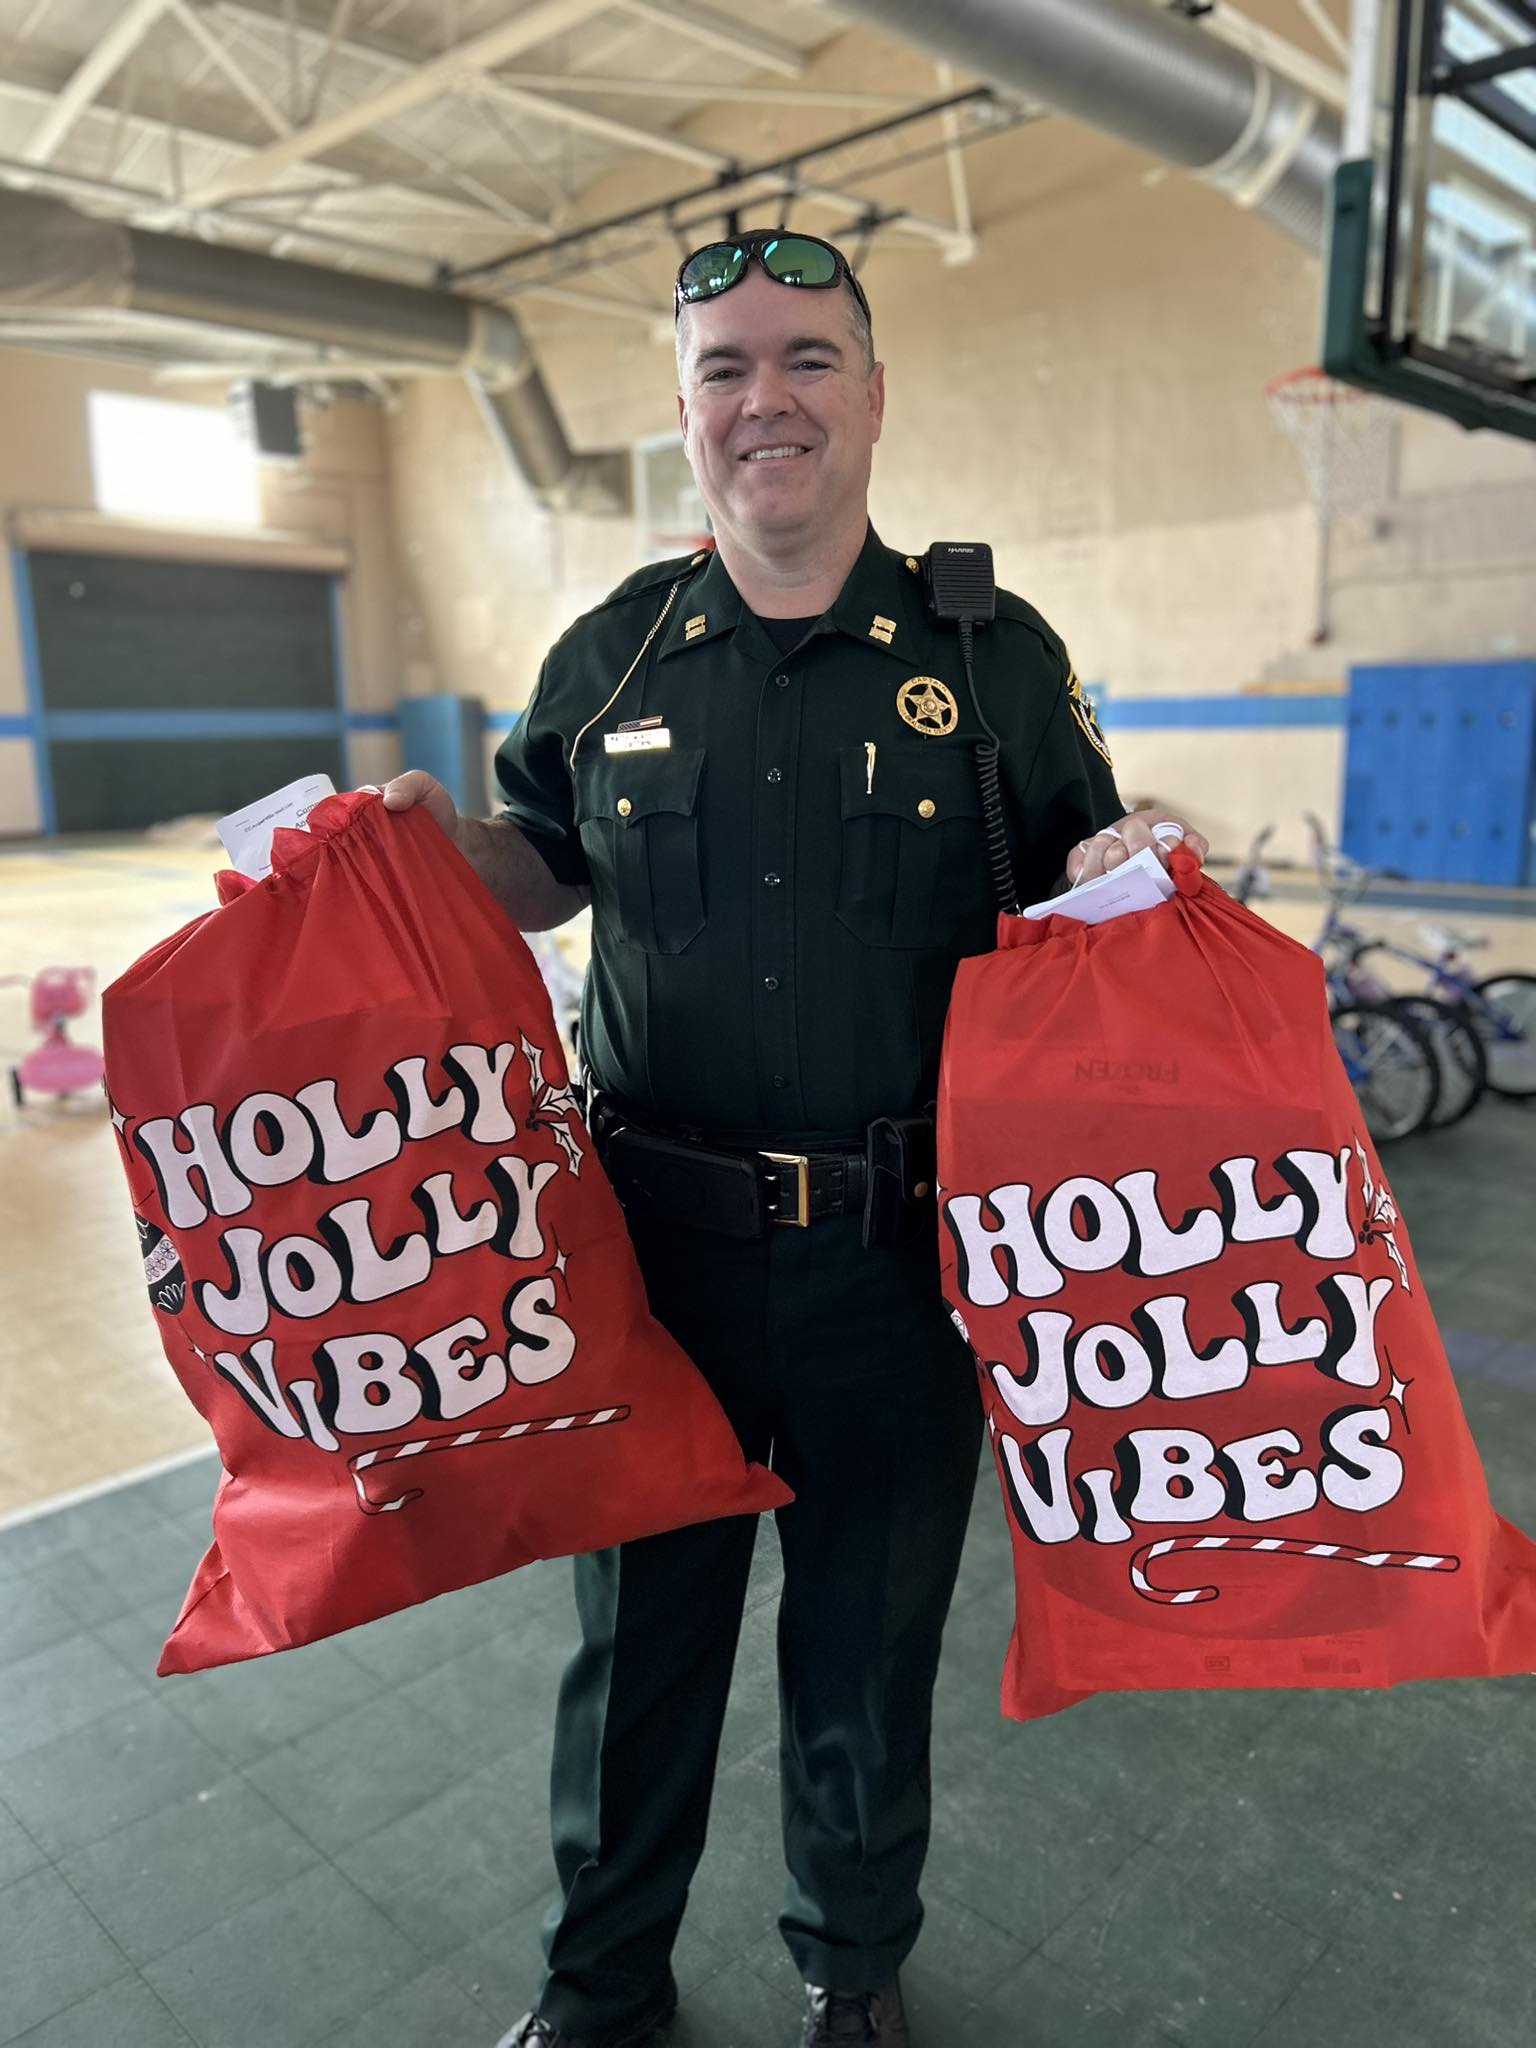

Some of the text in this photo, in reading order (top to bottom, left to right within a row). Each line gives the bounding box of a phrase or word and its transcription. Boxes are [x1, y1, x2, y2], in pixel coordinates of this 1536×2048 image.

[134, 1042, 516, 1229] HOLLY
[197, 1156, 560, 1335] JOLLY
[945, 1147, 1356, 1308] HOLLY
[214, 1277, 577, 1451] VIBES
[988, 1274, 1393, 1426] JOLLY
[1001, 1406, 1402, 1544] VIBES
